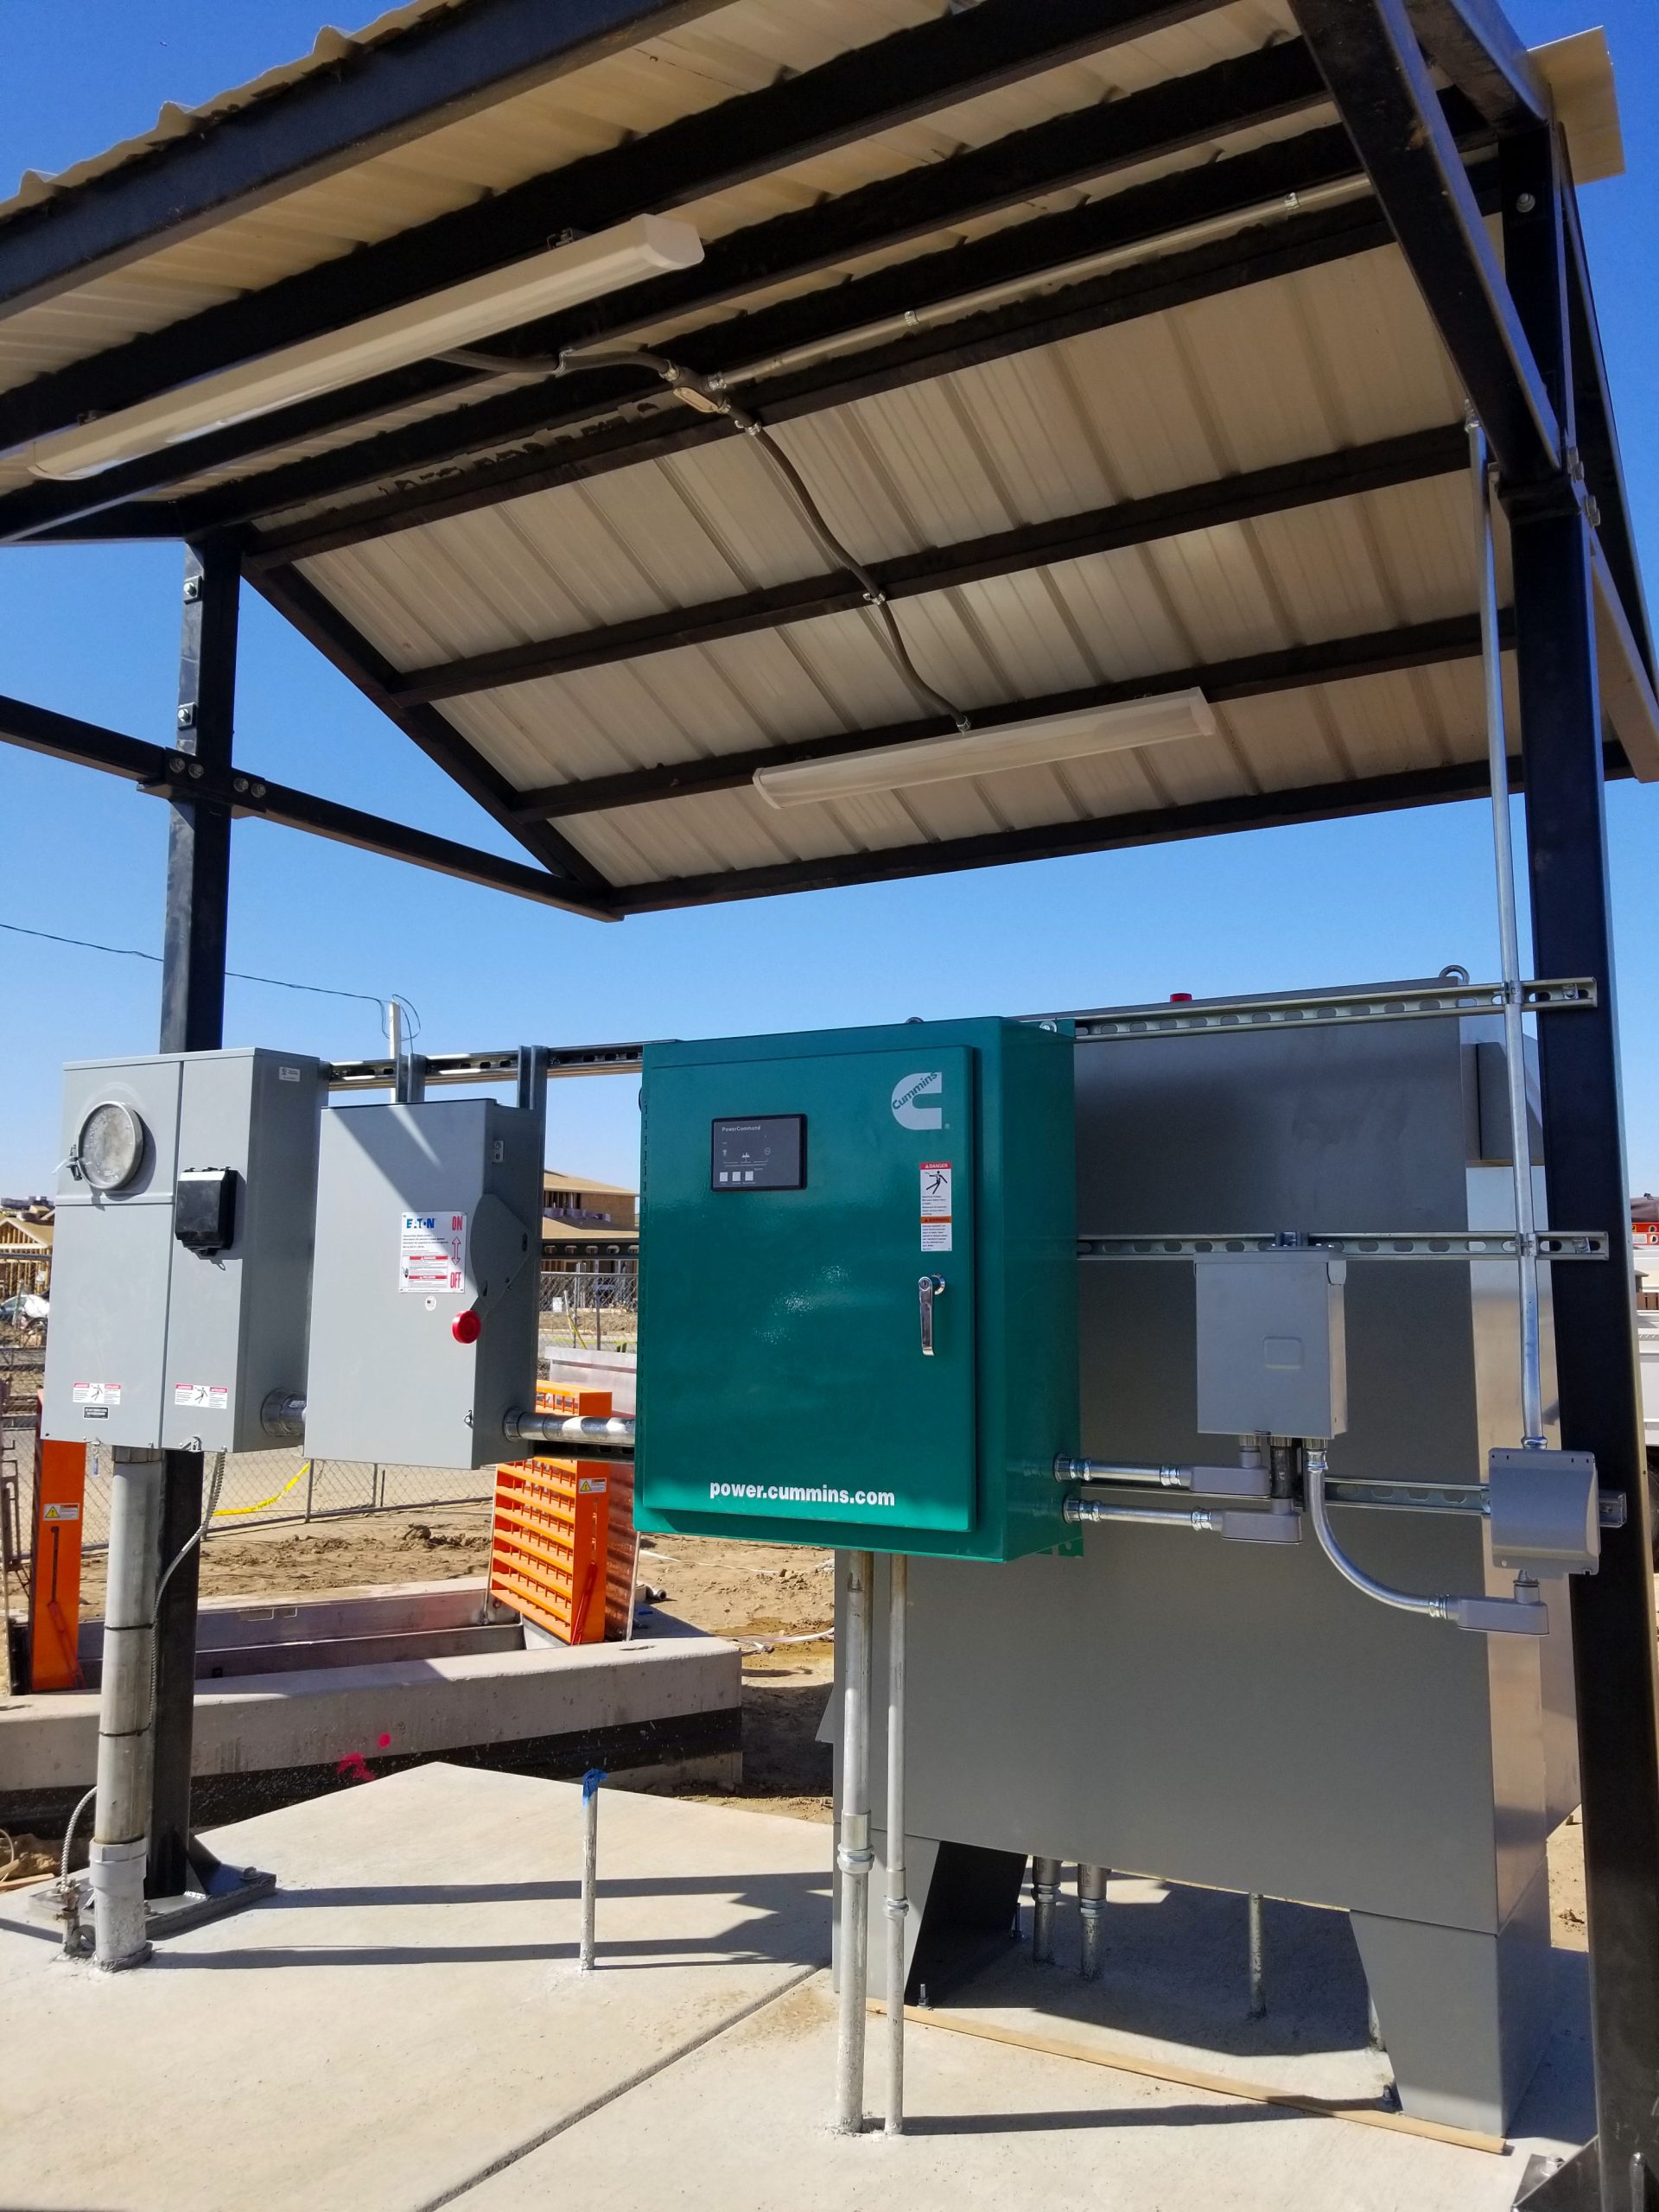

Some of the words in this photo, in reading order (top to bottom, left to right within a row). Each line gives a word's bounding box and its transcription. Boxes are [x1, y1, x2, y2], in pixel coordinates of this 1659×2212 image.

[893, 1071, 938, 1109] Cummins
[452, 1216, 462, 1230] ON
[450, 1272, 461, 1288] OFF
[709, 1482, 895, 1507] power.cummins.com
